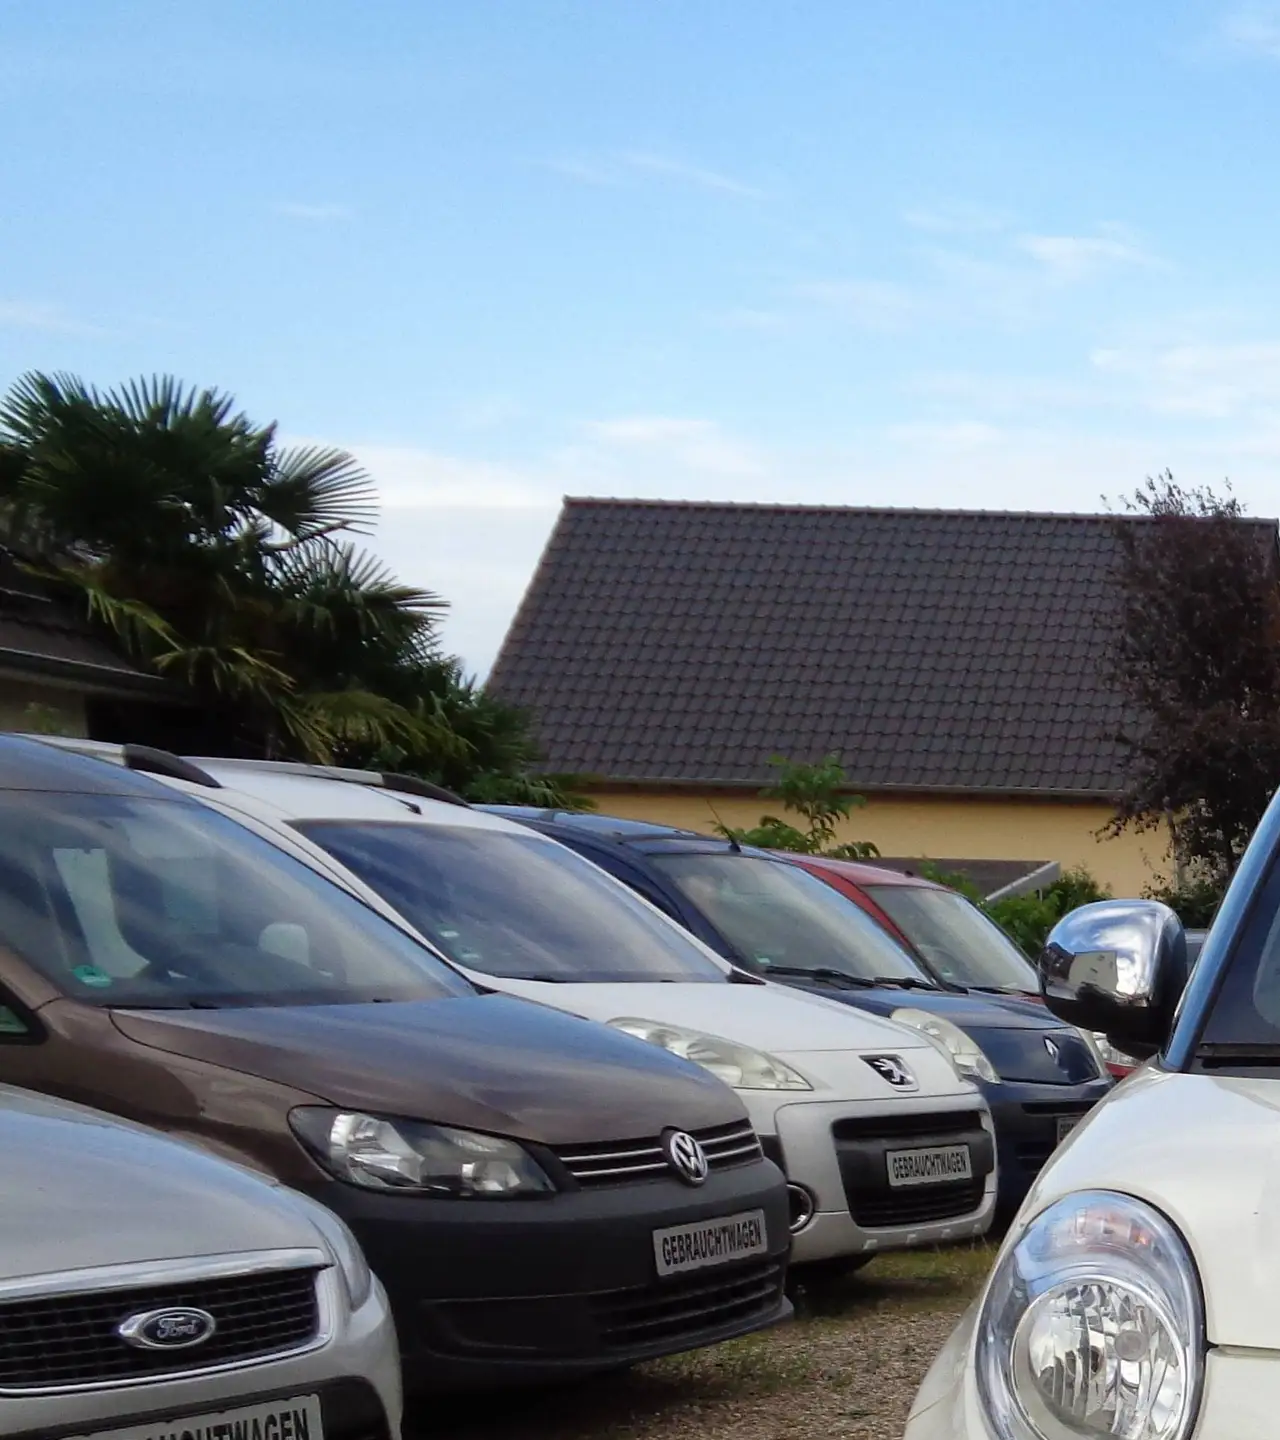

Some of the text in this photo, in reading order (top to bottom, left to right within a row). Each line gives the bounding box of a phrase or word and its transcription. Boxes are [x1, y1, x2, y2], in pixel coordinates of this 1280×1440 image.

[892, 1151, 968, 1180] GEBRAUCHTWAGEN
[662, 1218, 762, 1267] GEBRAUCHTWAGEN
[156, 1316, 197, 1339] Ford
